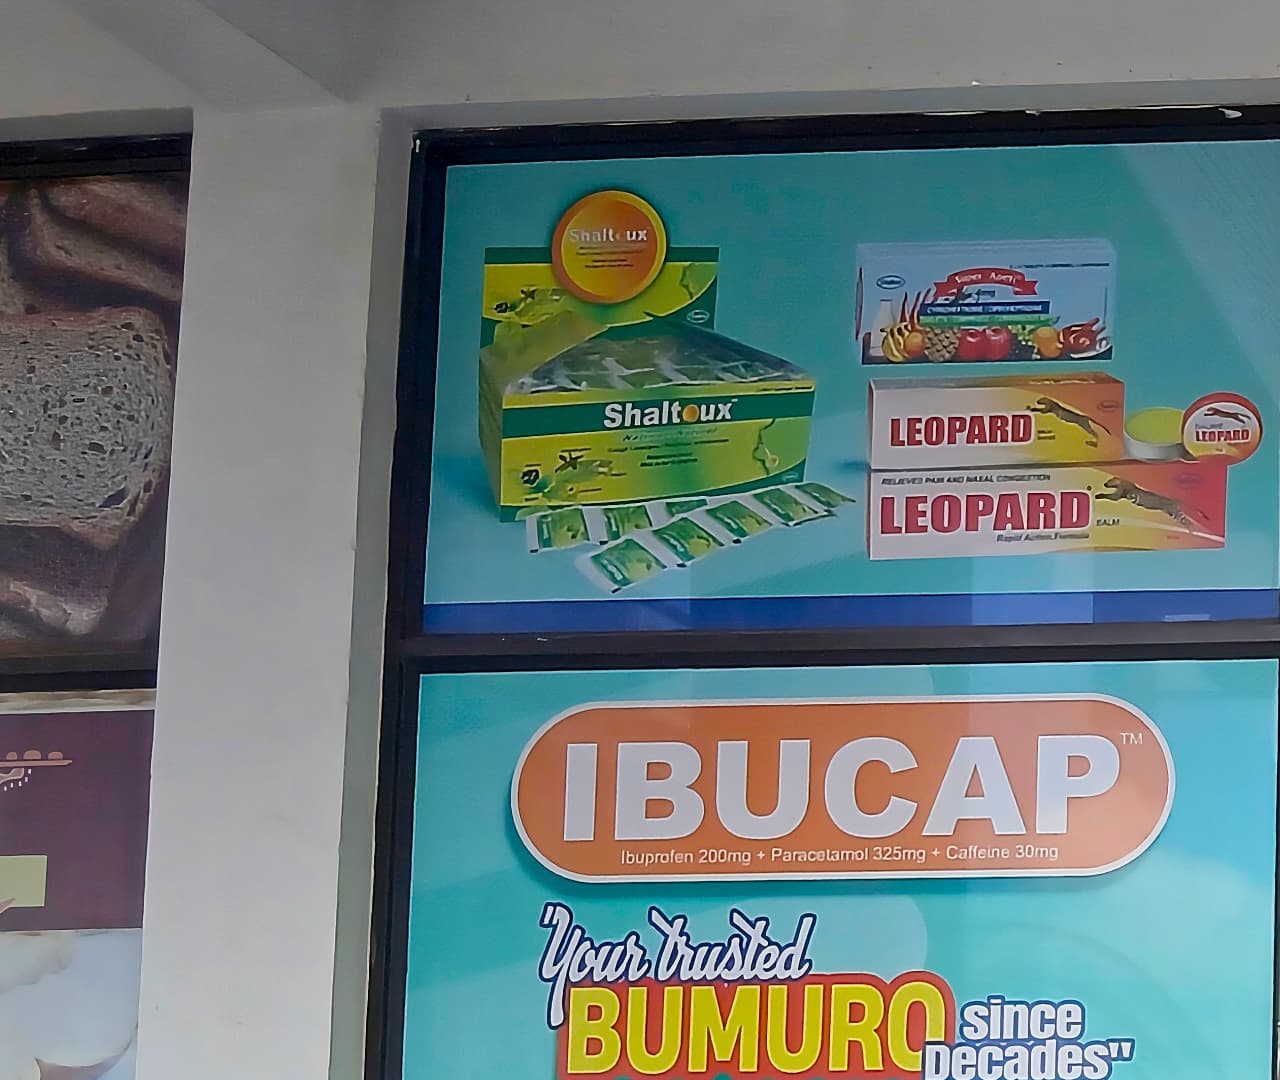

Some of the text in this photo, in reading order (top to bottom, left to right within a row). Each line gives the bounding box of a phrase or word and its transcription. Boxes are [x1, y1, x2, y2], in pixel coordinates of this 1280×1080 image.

[603, 398, 734, 429] Shaltoux
[890, 413, 1033, 447] LEOPARD
[1195, 429, 1249, 442] LEOPARD
[880, 491, 1091, 534] LEOPARD
[563, 731, 1121, 844] IBUCAP
[621, 844, 1059, 867] Ibuprofen 200mg Paracetamol 325mg Caffeine 30mg
[650, 907, 816, 982] trusted
[568, 980, 947, 1074] BUMURO
[961, 997, 1084, 1041] since
